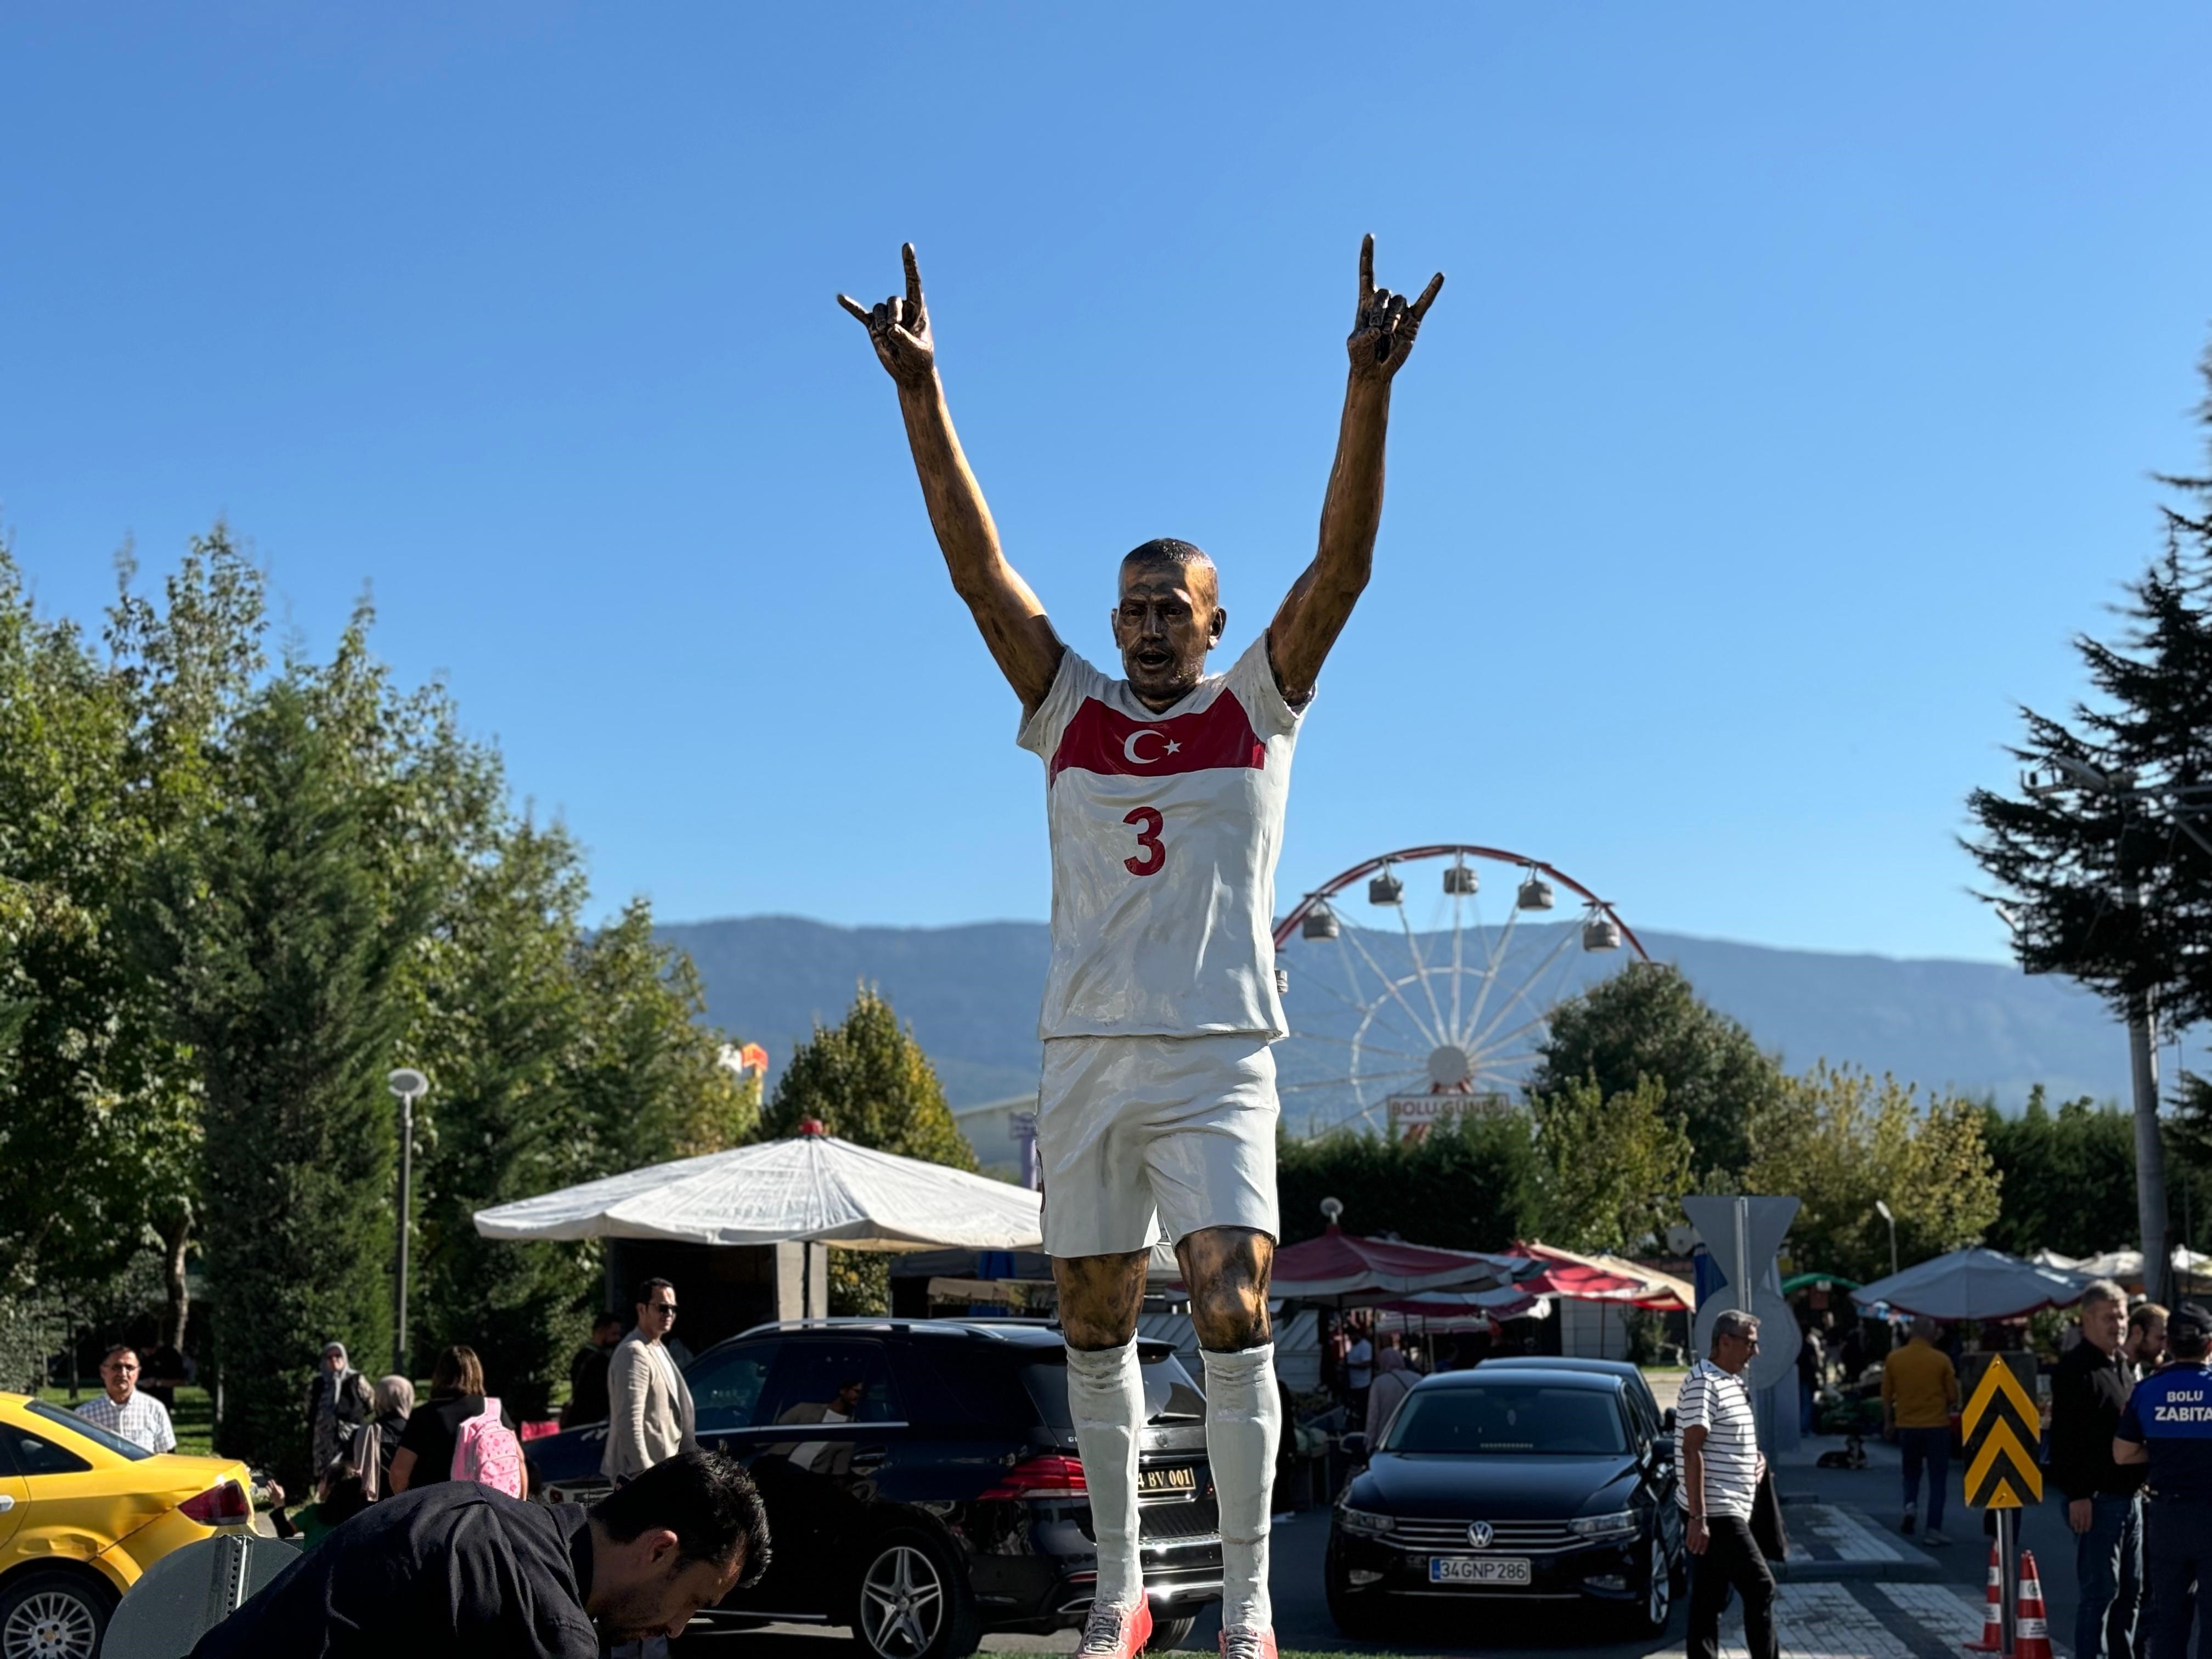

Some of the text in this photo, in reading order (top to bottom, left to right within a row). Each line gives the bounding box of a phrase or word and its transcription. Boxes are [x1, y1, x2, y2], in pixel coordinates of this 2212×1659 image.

[1123, 806, 1166, 876] 3
[1391, 1101, 1437, 1115] BOLU
[2166, 1390, 2203, 1402] BOLU
[2155, 1406, 2212, 1421] ZABITA
[1148, 1471, 1164, 1487] BV
[1169, 1469, 1190, 1486] 001
[1441, 1562, 1526, 1579] 34 GNP 286
